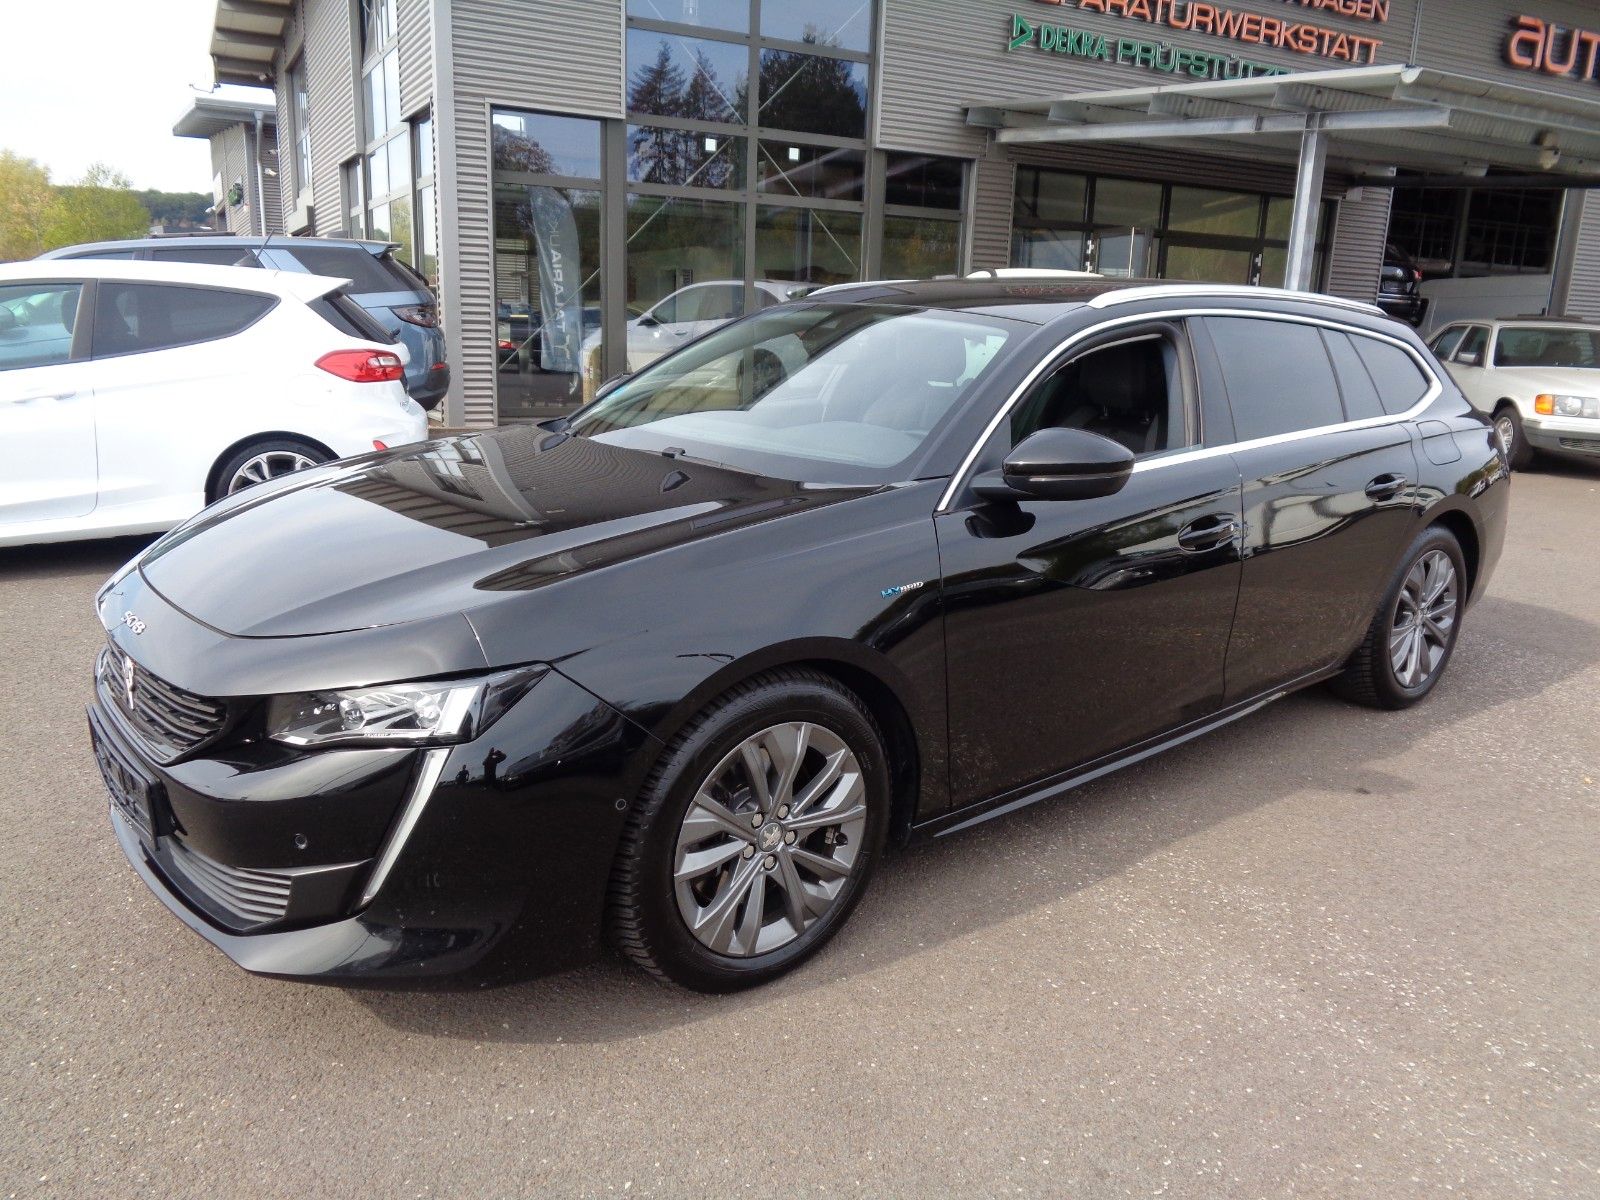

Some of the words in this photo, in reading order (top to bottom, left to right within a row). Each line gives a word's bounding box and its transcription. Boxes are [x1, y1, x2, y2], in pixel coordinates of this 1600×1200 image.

[1040, 0, 1383, 64] RATURWERKSTATT
[1298, 0, 1390, 22] GEN
[1040, 24, 1109, 61] DEKRA
[1116, 38, 1296, 80] PRÜFSTÜTZ
